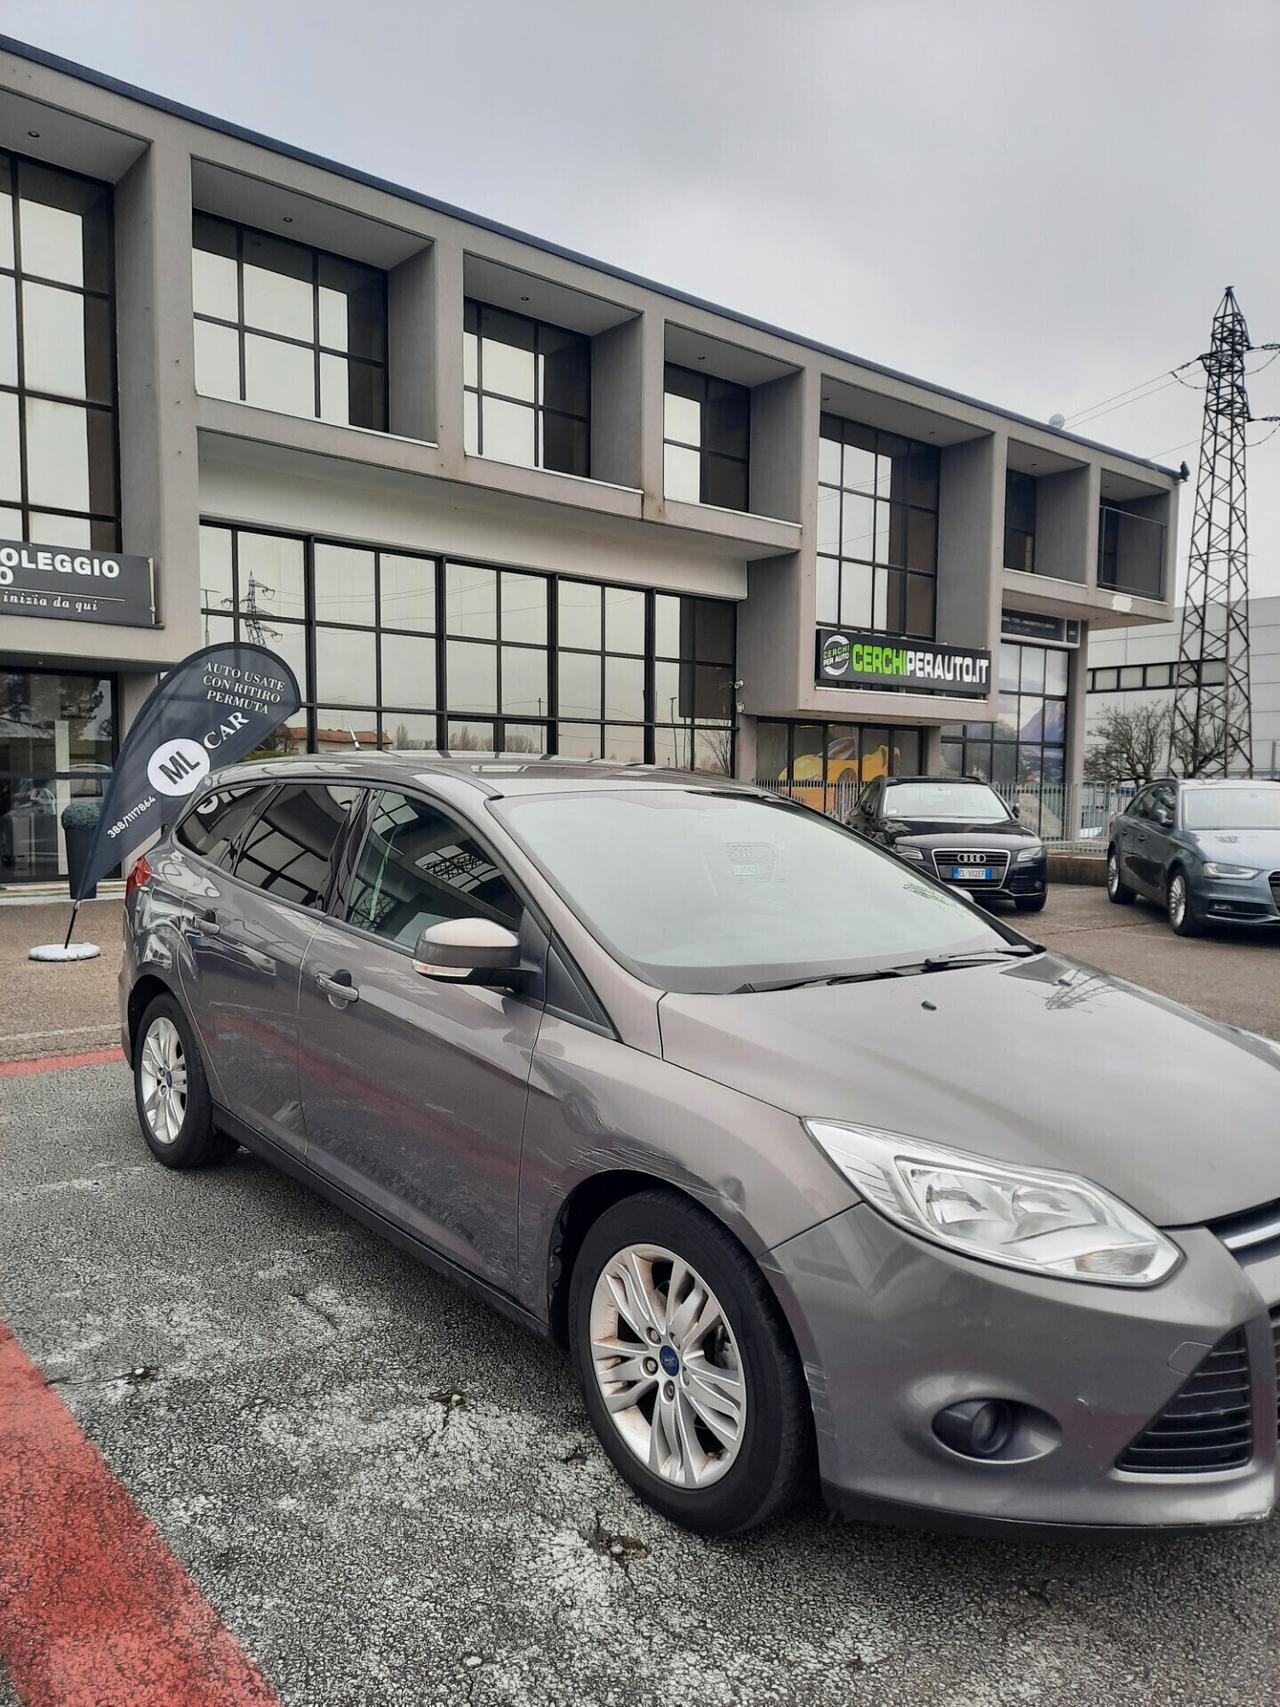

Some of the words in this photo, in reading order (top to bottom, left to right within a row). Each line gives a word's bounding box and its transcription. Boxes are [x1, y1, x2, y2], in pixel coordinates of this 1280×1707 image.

[3, 591, 48, 606] inizia
[53, 596, 70, 609] da
[823, 644, 850, 659] CERCHI
[823, 657, 834, 667] PER
[834, 652, 850, 663] AUTO
[852, 643, 990, 684] CERCHIPERAUTO.IT
[203, 661, 241, 679] AUTO
[244, 671, 286, 692] USATE
[203, 675, 231, 690] CON
[234, 682, 281, 703] RITIRO
[206, 689, 269, 714] PERMUTA
[158, 750, 201, 785] ML
[203, 711, 250, 750] CAR
